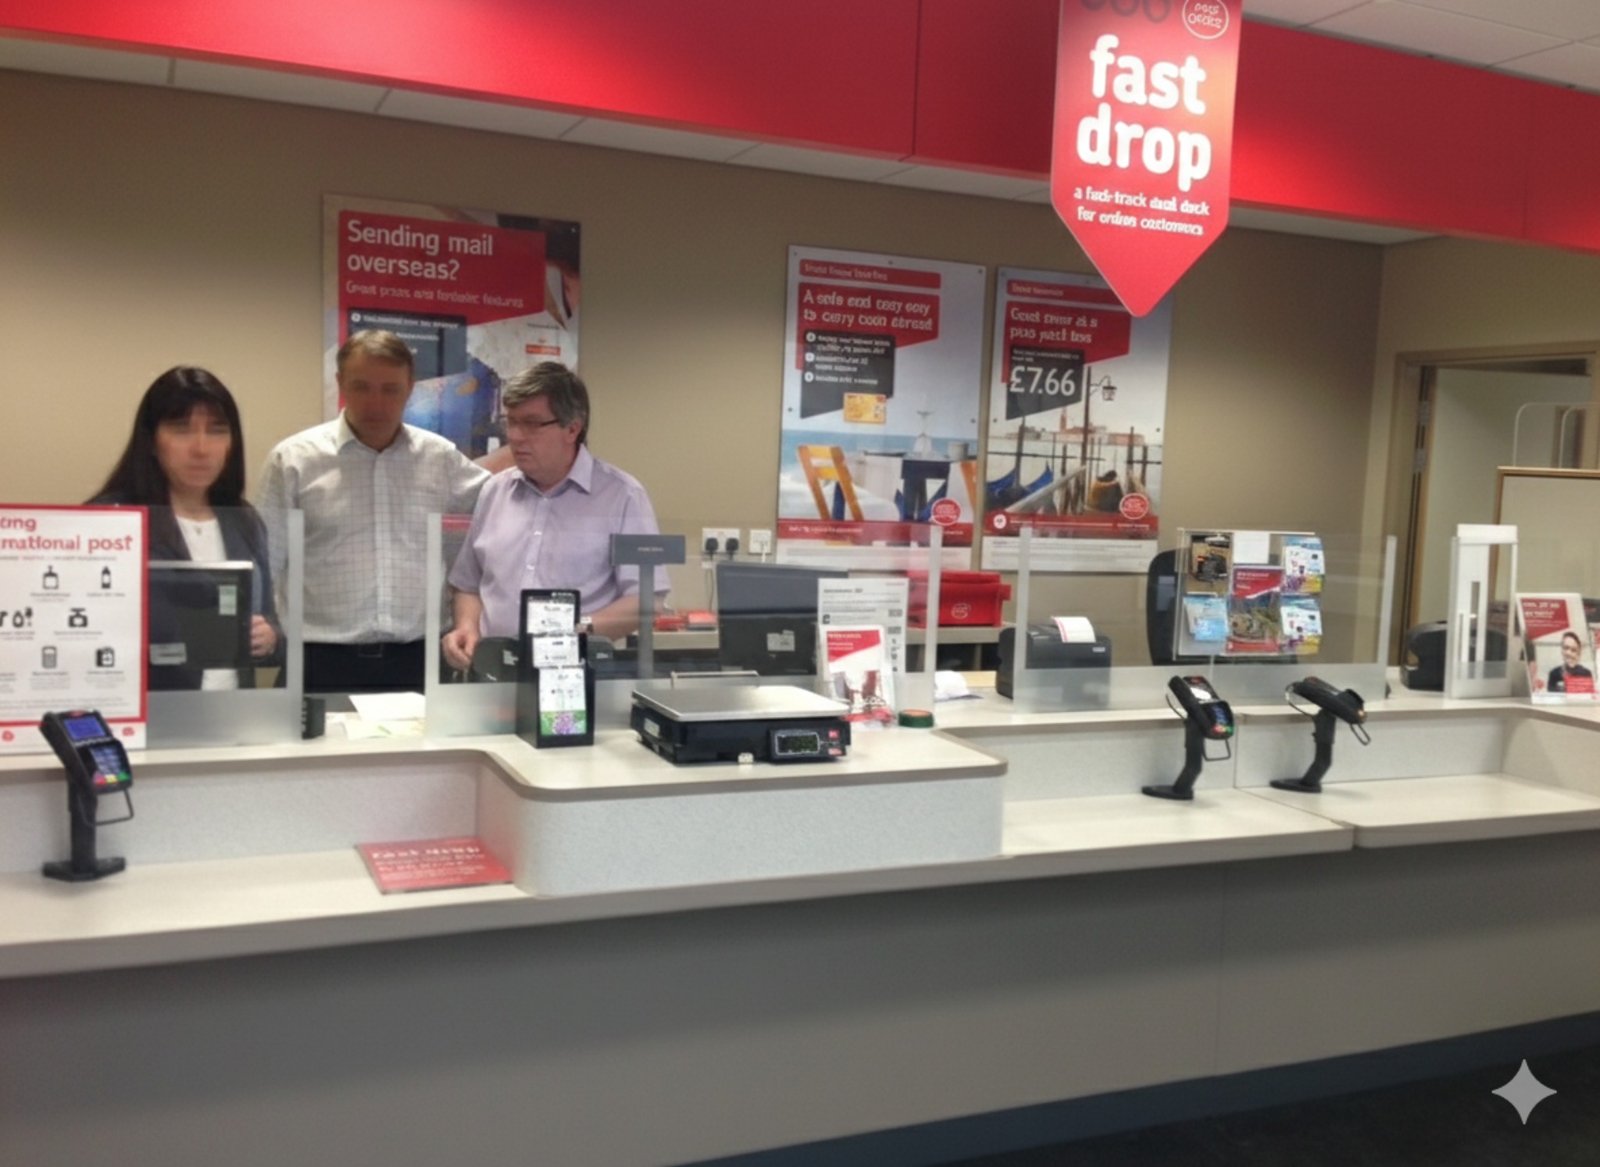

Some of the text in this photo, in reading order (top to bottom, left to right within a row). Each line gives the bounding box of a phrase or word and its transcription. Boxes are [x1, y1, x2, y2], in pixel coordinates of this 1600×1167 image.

[1089, 34, 1206, 115] fast
[1076, 102, 1212, 192] drop
[1073, 187, 1083, 200] a
[347, 219, 493, 256] Sending mail
[346, 254, 460, 280] overseas?
[803, 288, 815, 304] A
[1010, 365, 1075, 396] £7.66
[88, 534, 133, 554] post
